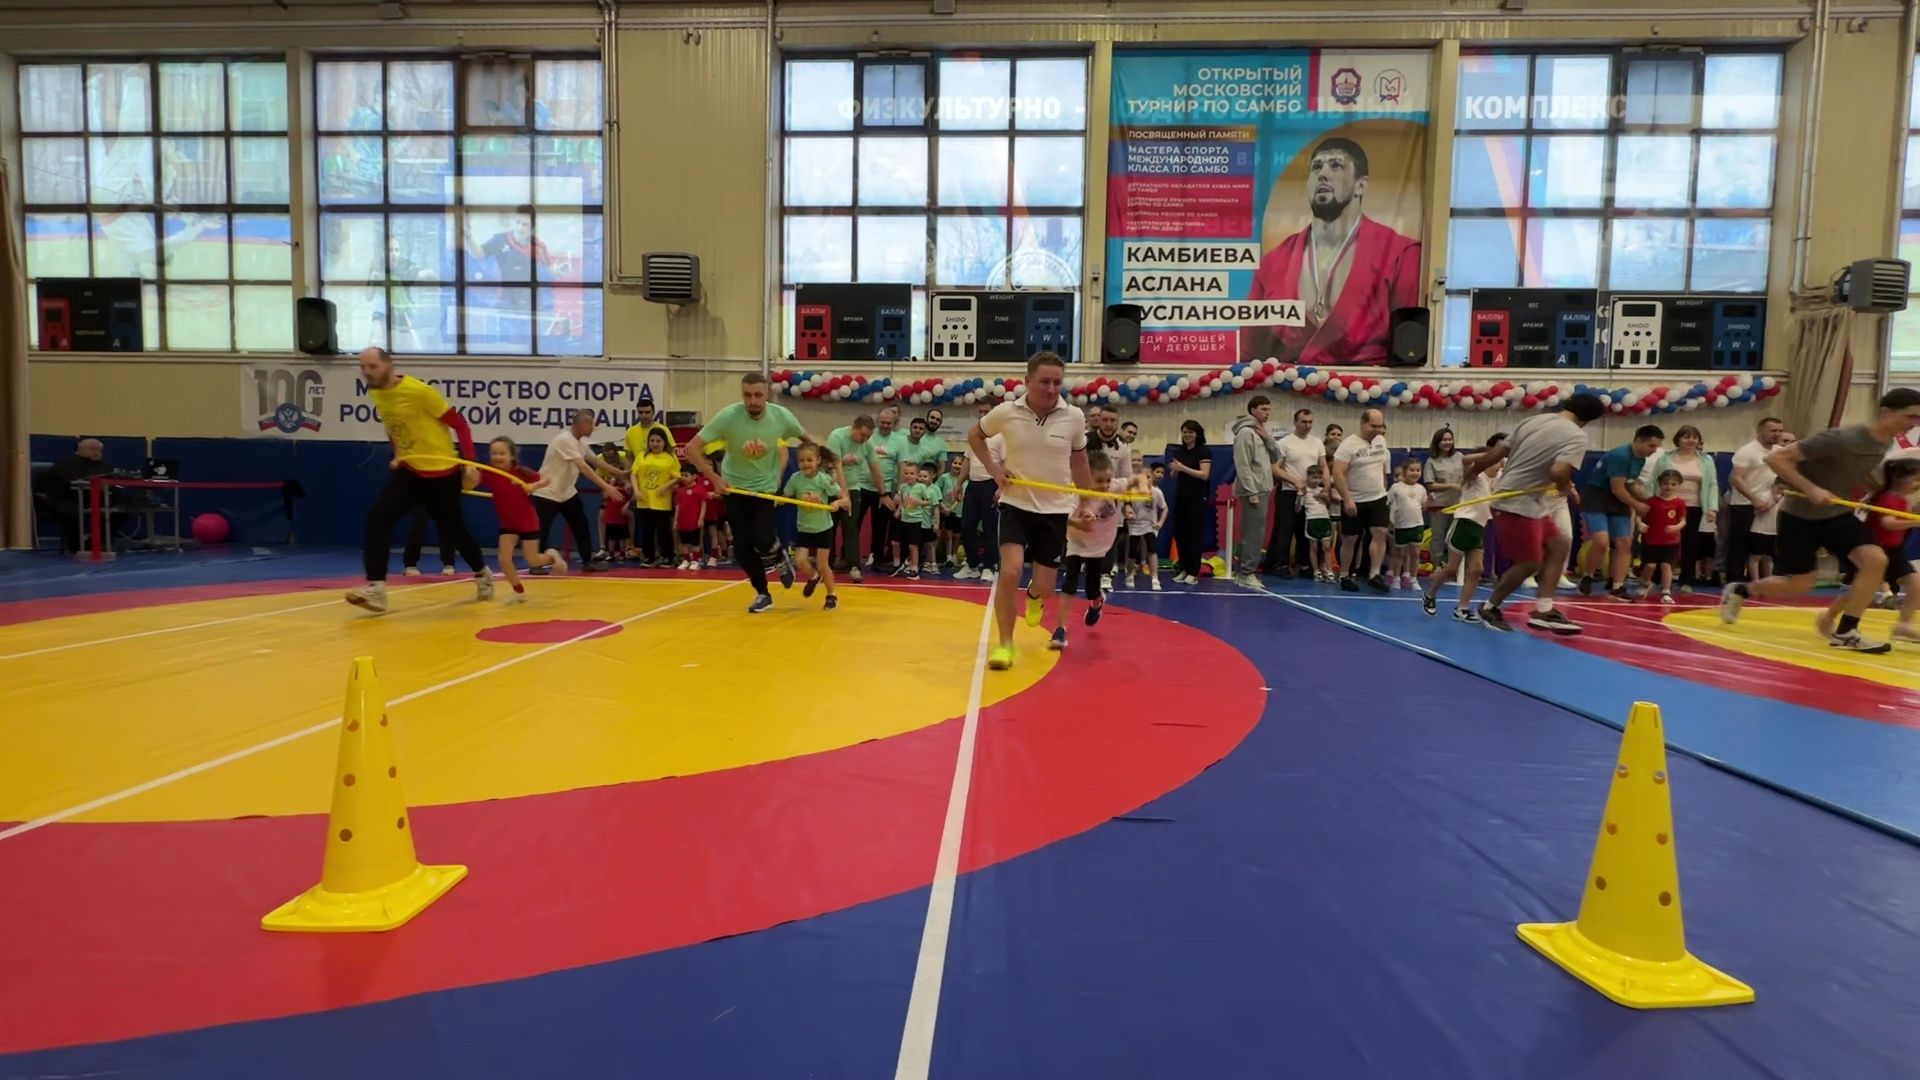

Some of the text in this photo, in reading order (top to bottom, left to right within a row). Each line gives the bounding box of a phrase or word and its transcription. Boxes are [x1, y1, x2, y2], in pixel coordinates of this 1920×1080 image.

[1198, 64, 1302, 81] ОТКРЫТЫЙ
[1173, 81, 1301, 97] МОСКОВСКИЙ
[837, 96, 1061, 120] ФИЗКУЛЬТУРНО
[1128, 100, 1302, 114] ТУРНИР ПО САМБО
[1465, 96, 1626, 120] КОМПЛЕКС
[1128, 129, 1250, 140] ПОСВЯЩЕННЫЙ ПАМЯТИ
[1128, 145, 1229, 155] МАСТЕРА СПОРТА
[1128, 155, 1229, 165] МЕЖДУНАРОДНОГО
[1127, 164, 1229, 174] КЛАССА ПО САМБО
[1127, 246, 1256, 263] КАМБИЕВА
[1125, 276, 1223, 292] АСЛАНА
[1139, 304, 1301, 321] УСЛАНОВИЧА
[1139, 334, 1226, 344] ЕДИ ЮНОШЕЙ
[1731, 341, 1741, 349] W
[1165, 344, 1226, 353] ДЕВУШЕК
[308, 386, 326, 395] ЛЕТ
[558, 381, 655, 402] СПОРТА
